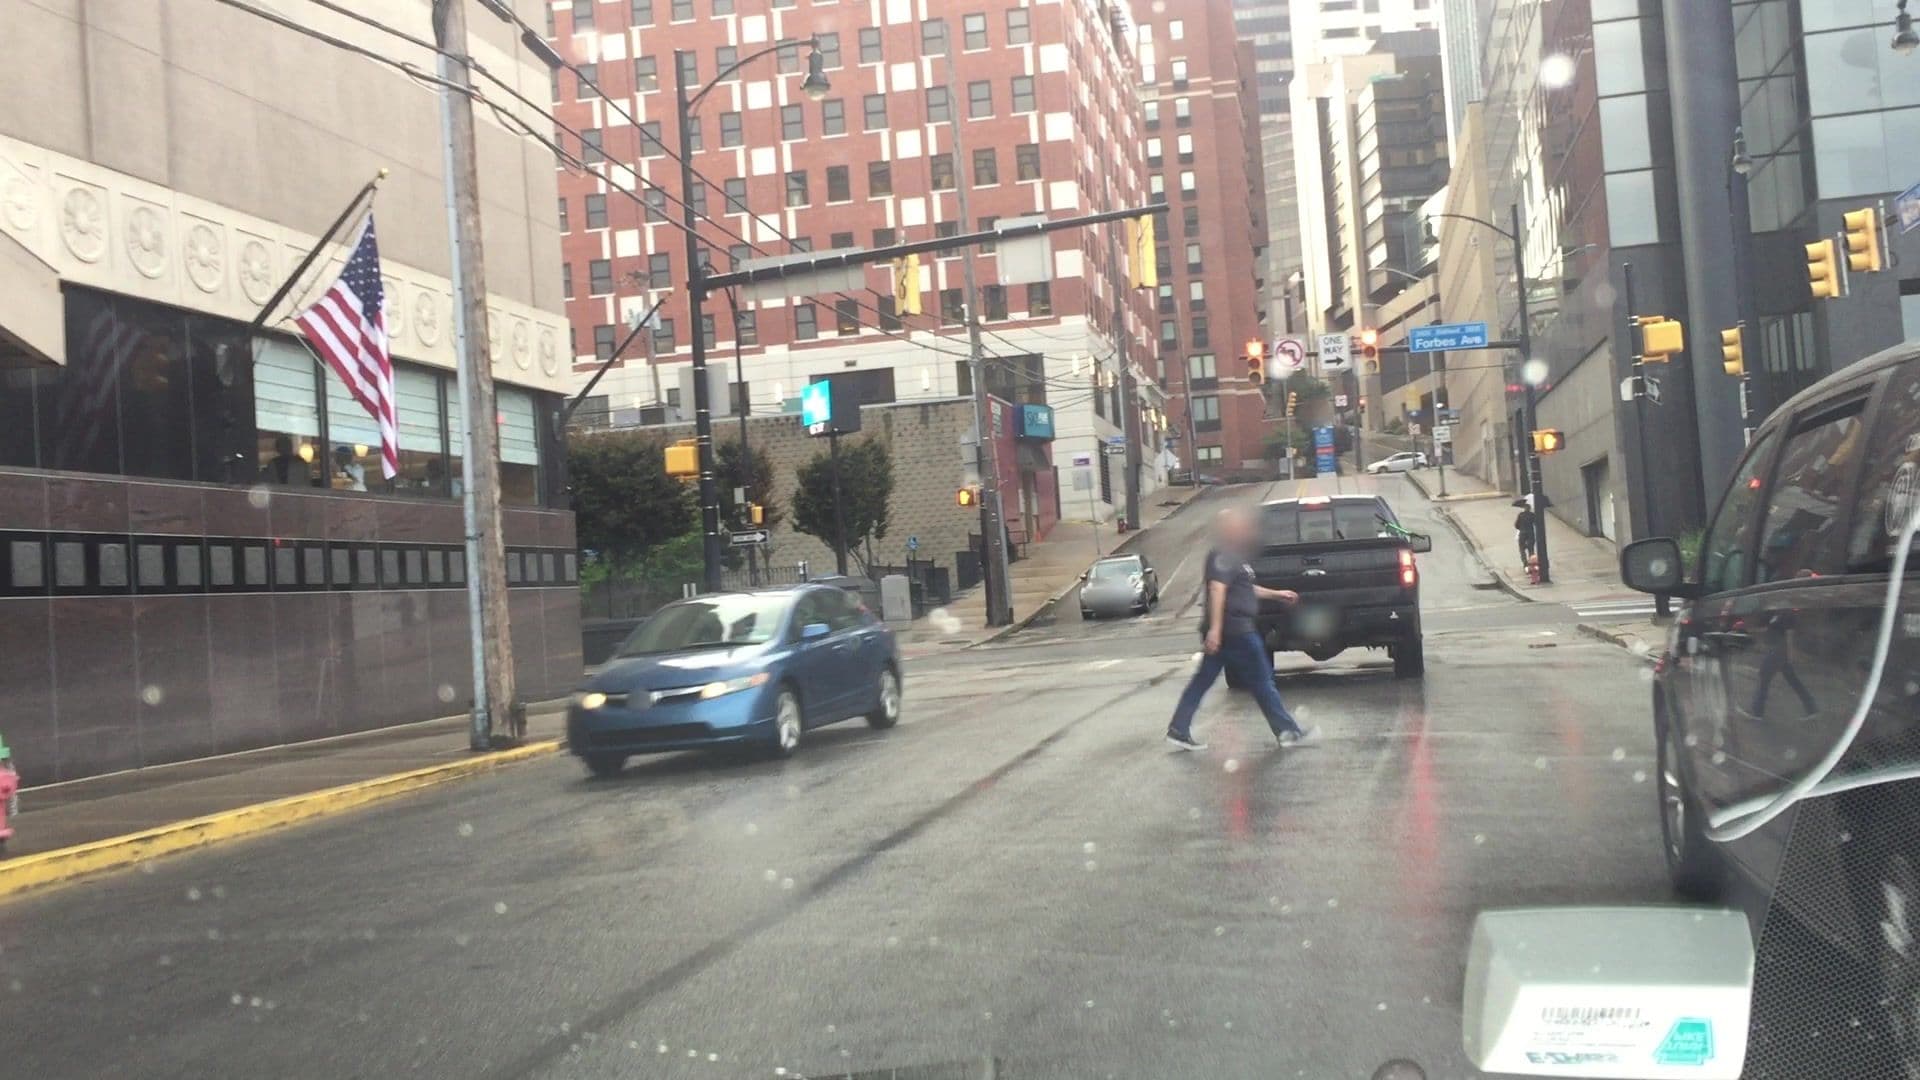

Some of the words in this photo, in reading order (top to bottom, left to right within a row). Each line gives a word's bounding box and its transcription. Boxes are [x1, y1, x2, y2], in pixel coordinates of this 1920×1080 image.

[1323, 336, 1344, 345] ONE
[1415, 337, 1456, 350] Forbes
[1324, 345, 1343, 355] WAY
